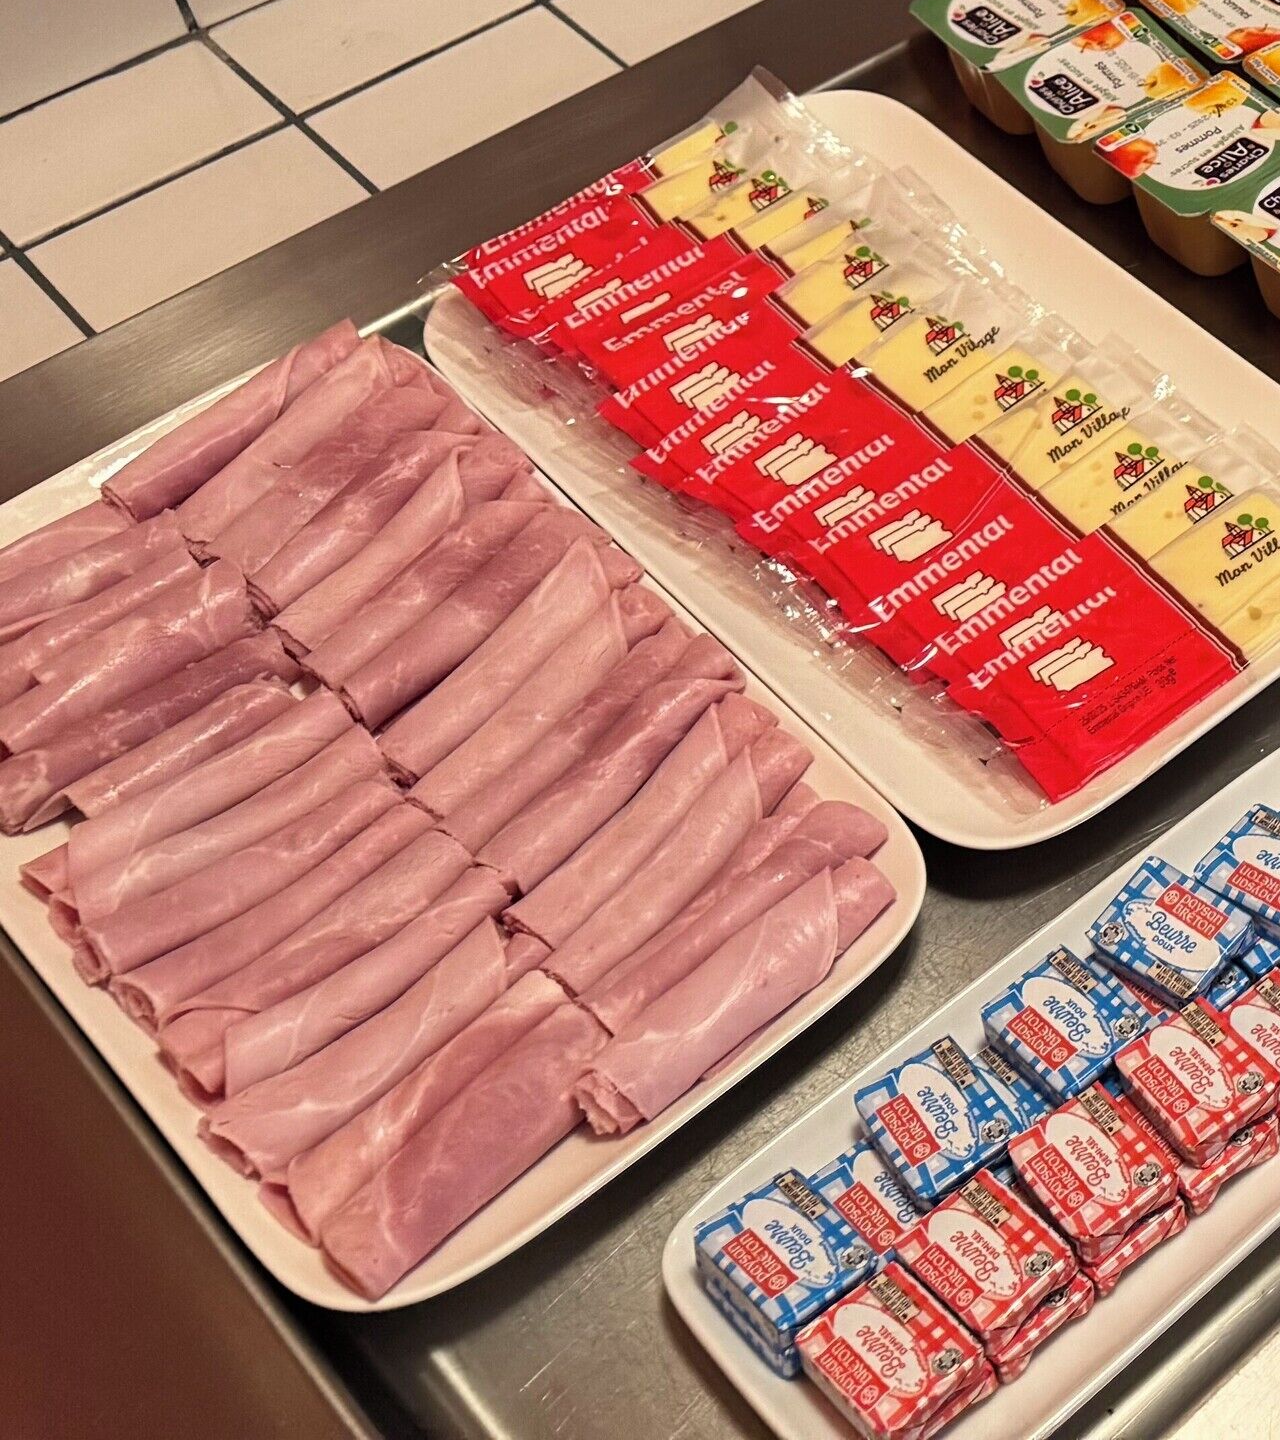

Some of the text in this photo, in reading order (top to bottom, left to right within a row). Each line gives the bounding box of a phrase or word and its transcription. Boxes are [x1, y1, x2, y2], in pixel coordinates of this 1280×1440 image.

[1038, 83, 1076, 115] Charles
[1053, 75, 1094, 107] Alice
[1174, 125, 1223, 154] Pommes
[1201, 141, 1248, 173] Alice
[1219, 147, 1264, 179] Charles
[602, 270, 748, 352] Emmental
[923, 357, 958, 384] Mon
[1046, 439, 1083, 464] Mon
[807, 457, 953, 555] Emmental
[869, 514, 1015, 623] Emmental
[1214, 561, 1253, 588] Mon
[936, 548, 1083, 656] Emmental
[1231, 873, 1276, 902] paysan
[1172, 902, 1215, 936] BRETON
[1180, 894, 1224, 927] paysan
[1146, 912, 1199, 954] Beurre
[1151, 934, 1176, 954] DOUX
[1021, 1009, 1062, 1048] BRETON
[1042, 995, 1090, 1043] Beurre
[1066, 997, 1088, 1019] DOUX
[1011, 1020, 1050, 1057] paysan
[1136, 1068, 1175, 1106] paysan
[1148, 1058, 1184, 1097] BRETON
[1169, 1046, 1214, 1094] Beurre
[892, 1097, 928, 1142] BRETON
[916, 1085, 959, 1140] Beurre
[939, 1091, 959, 1114] DOUX
[880, 1106, 914, 1150] paysan
[1030, 1156, 1067, 1200] paysan
[1043, 1147, 1079, 1190] BRETON
[1066, 1135, 1110, 1188] Beurre
[740, 1232, 781, 1272] BRETON
[765, 1220, 814, 1270] Beurre
[790, 1224, 812, 1244] DOUX
[728, 1242, 769, 1283] paysan
[927, 1245, 967, 1288] BRETON
[950, 1230, 999, 1282] Beurre
[915, 1258, 957, 1300] paysan
[832, 1341, 872, 1384] BRETON
[856, 1325, 905, 1379] Beurre
[820, 1354, 857, 1397] paysan
